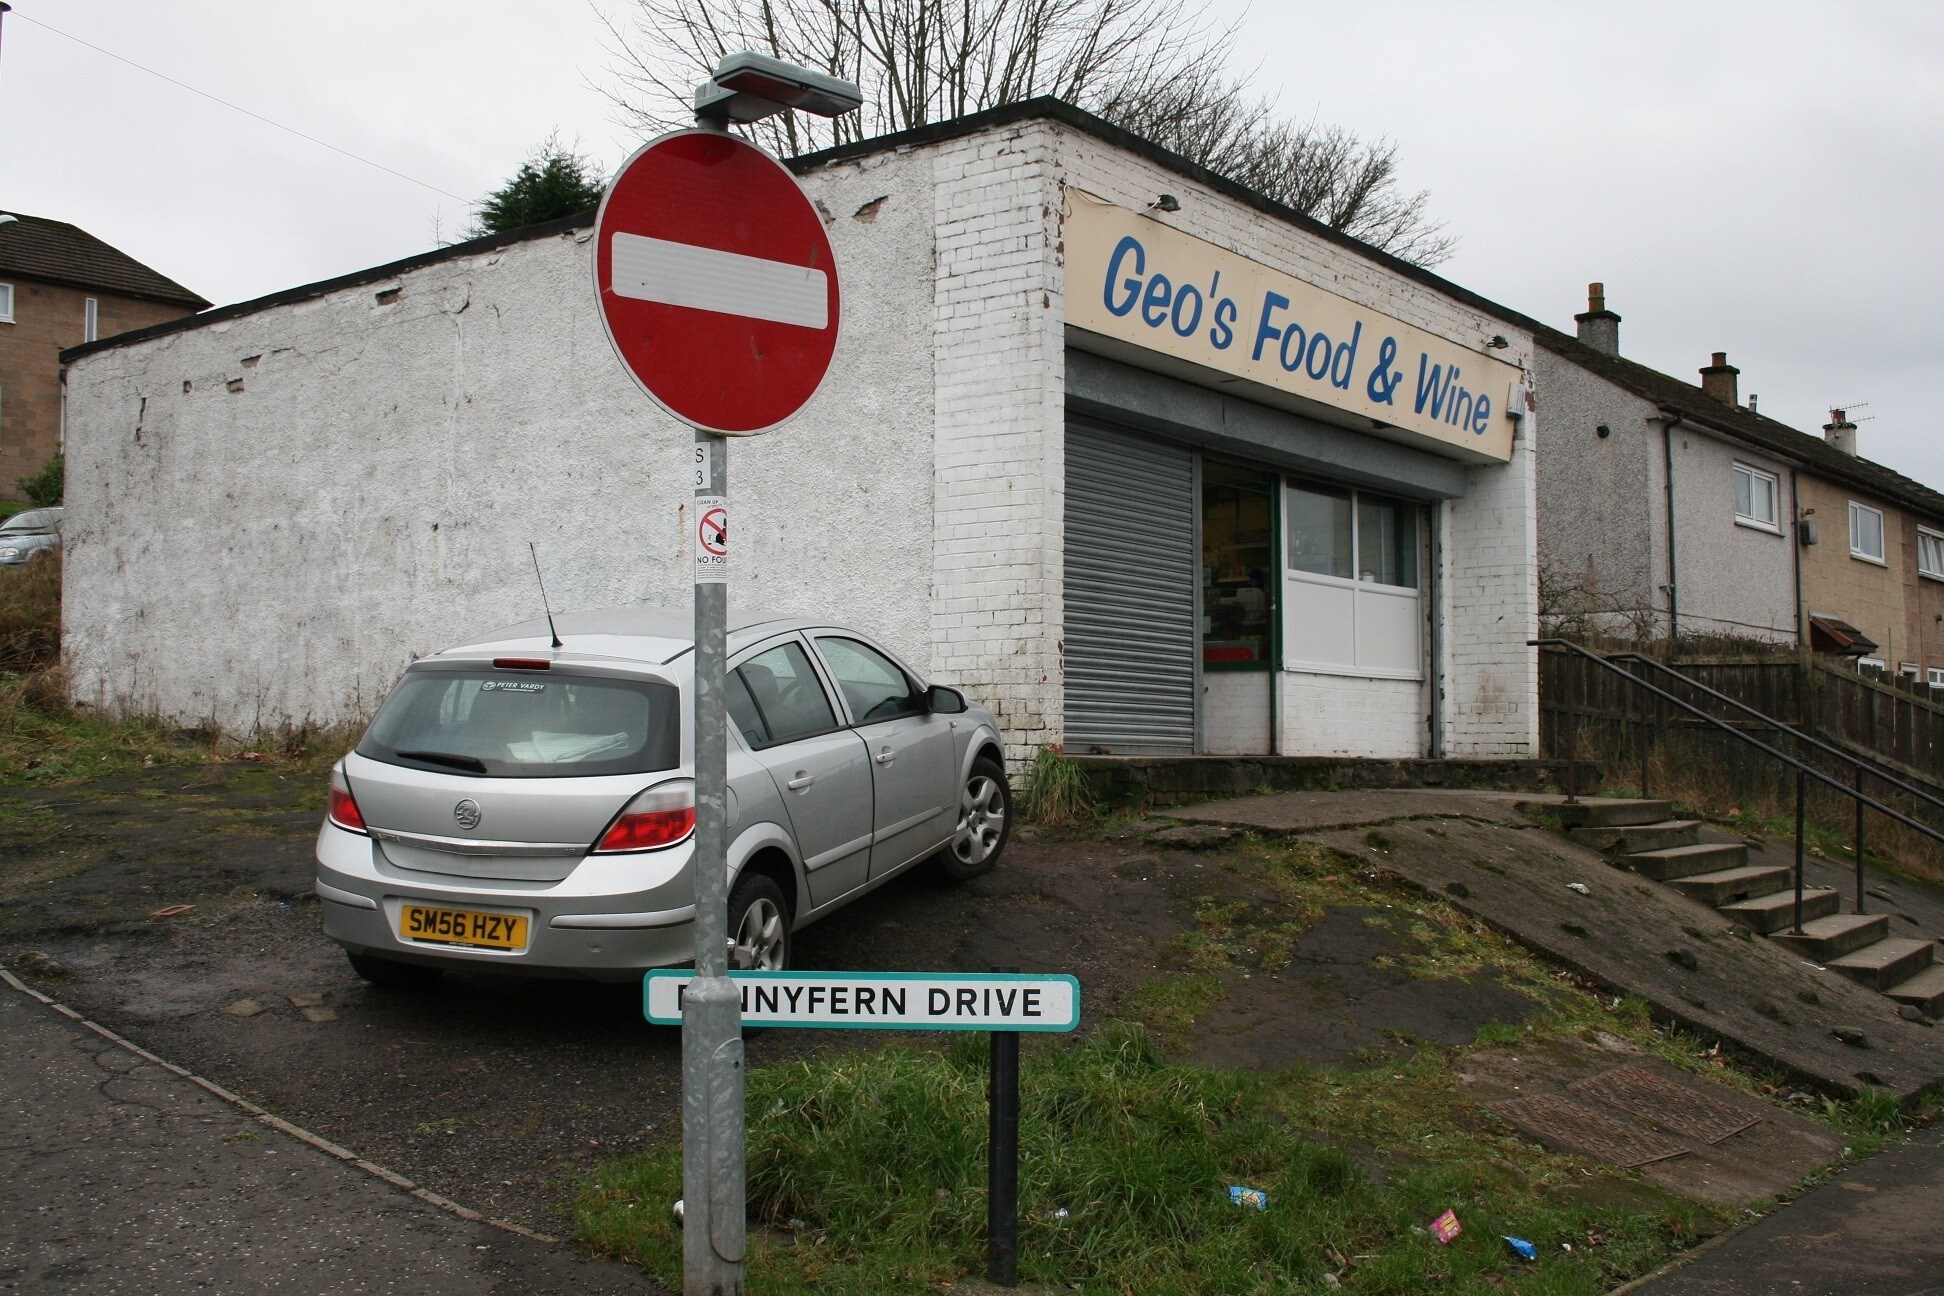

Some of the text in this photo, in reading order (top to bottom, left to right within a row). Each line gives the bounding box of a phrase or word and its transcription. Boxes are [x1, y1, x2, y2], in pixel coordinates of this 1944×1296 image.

[1103, 235, 1491, 436] Geo's Food & Wine
[695, 447, 704, 463] S
[695, 470, 704, 485] 3
[409, 908, 517, 941] SM56 HZY
[677, 984, 1042, 1017] NYFERN DRIVE
